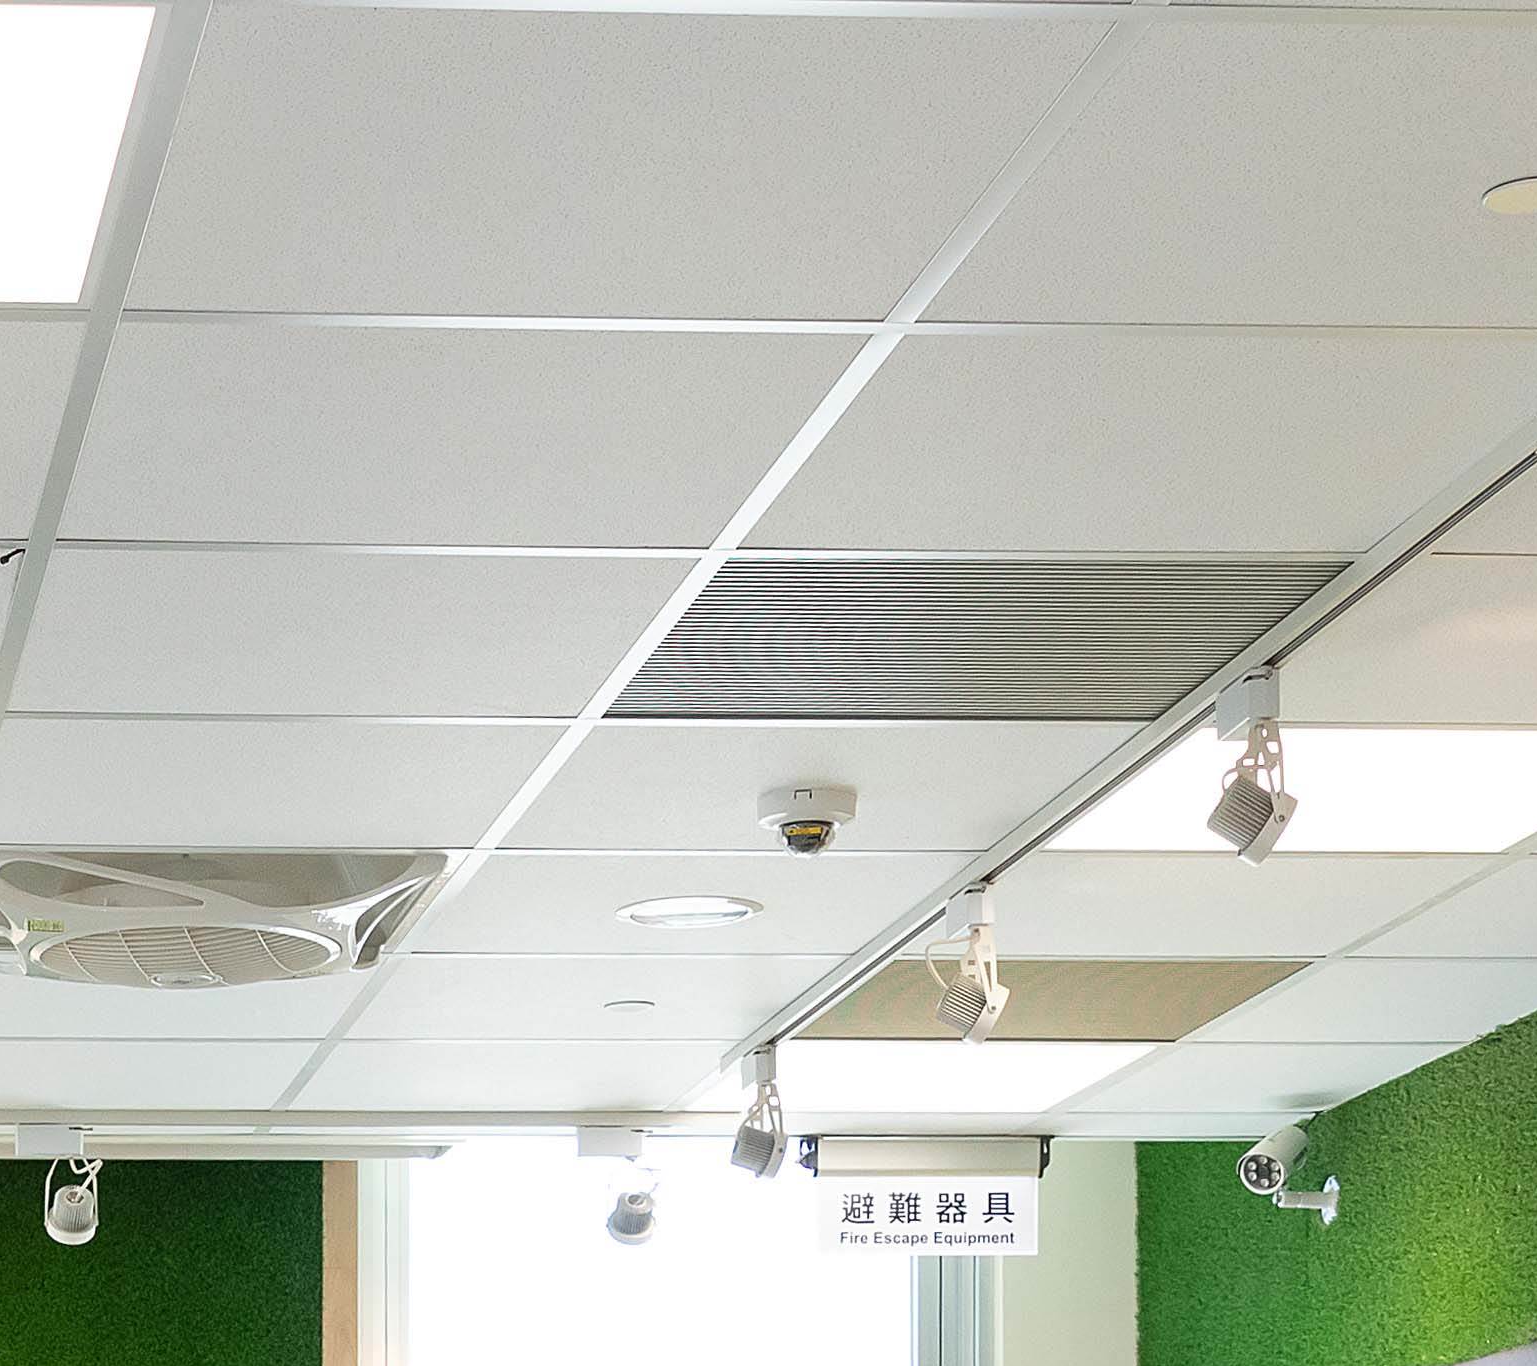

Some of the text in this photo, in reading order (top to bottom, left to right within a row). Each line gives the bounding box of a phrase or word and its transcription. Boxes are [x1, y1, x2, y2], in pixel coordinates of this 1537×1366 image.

[841, 1191, 1016, 1225] 避難器具
[840, 1231, 1016, 1247] Fire Escape Equipment
